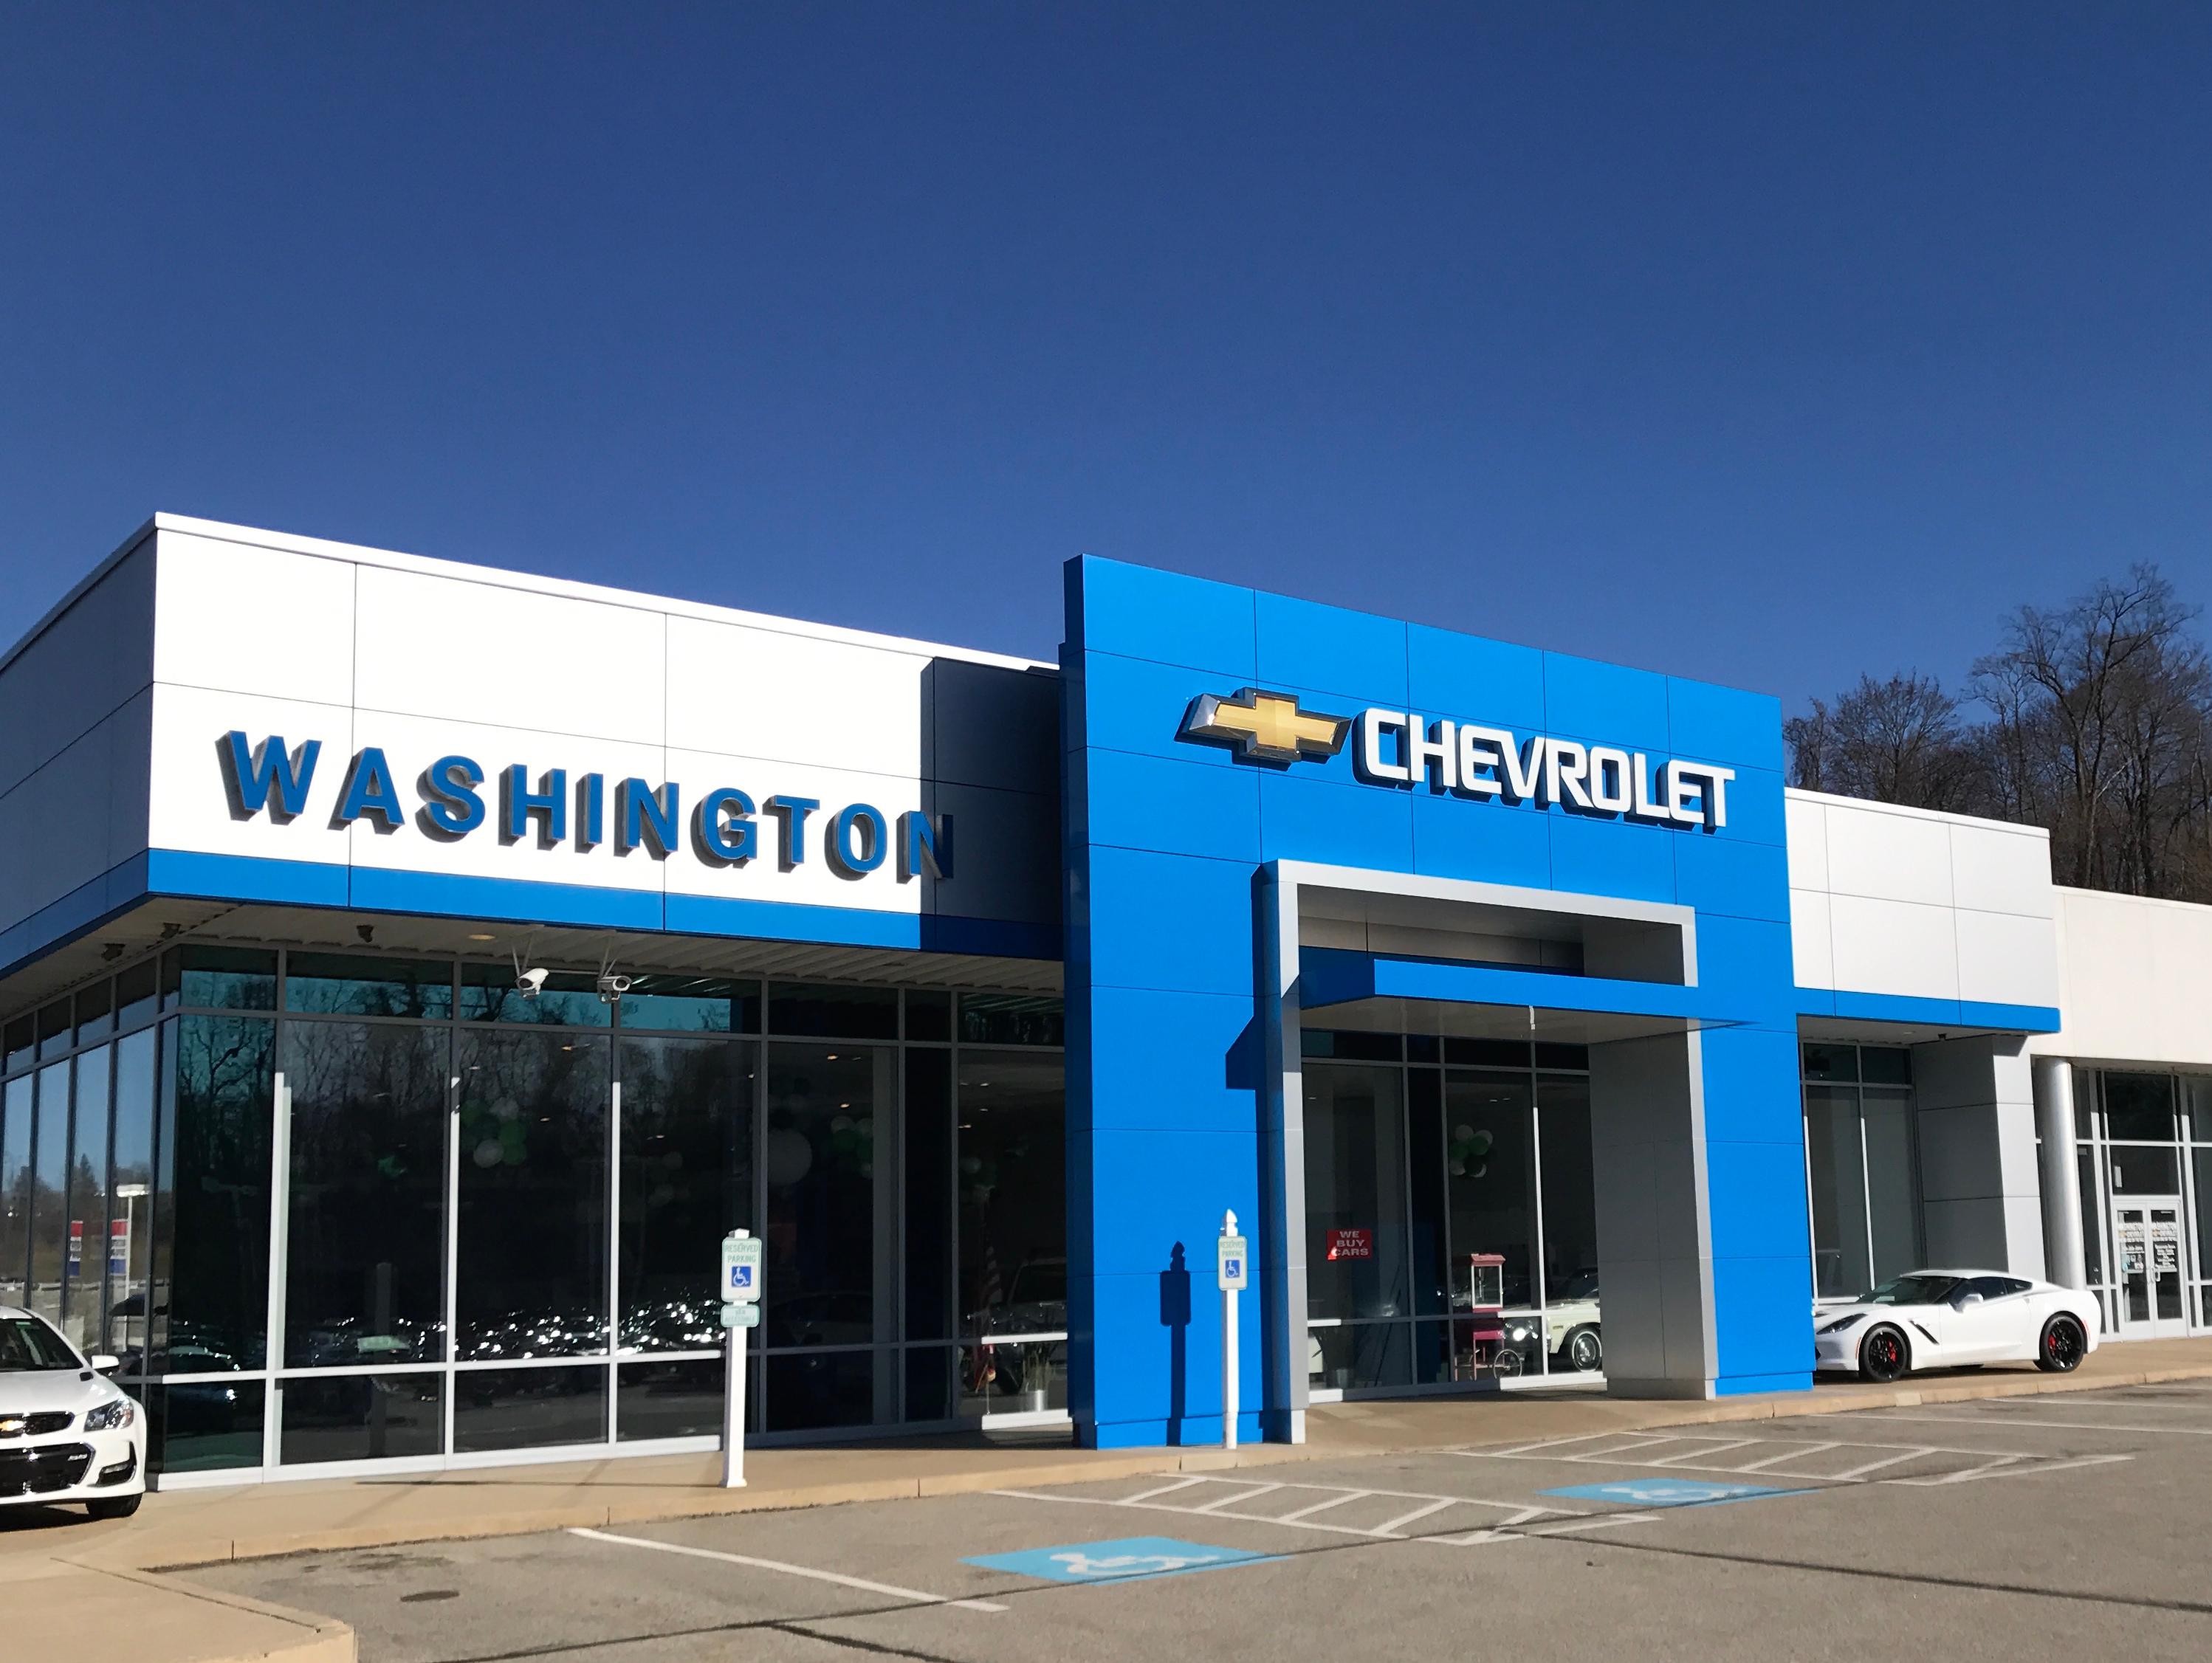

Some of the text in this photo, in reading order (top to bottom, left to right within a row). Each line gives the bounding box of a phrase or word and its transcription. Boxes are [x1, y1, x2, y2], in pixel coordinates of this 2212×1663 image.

[1356, 706, 1737, 831] CHEVROLET
[215, 730, 955, 884] WASHINGTON
[1336, 1239, 1364, 1247] BUY
[1334, 1247, 1369, 1256] CARS
[727, 1255, 756, 1263] PARKING
